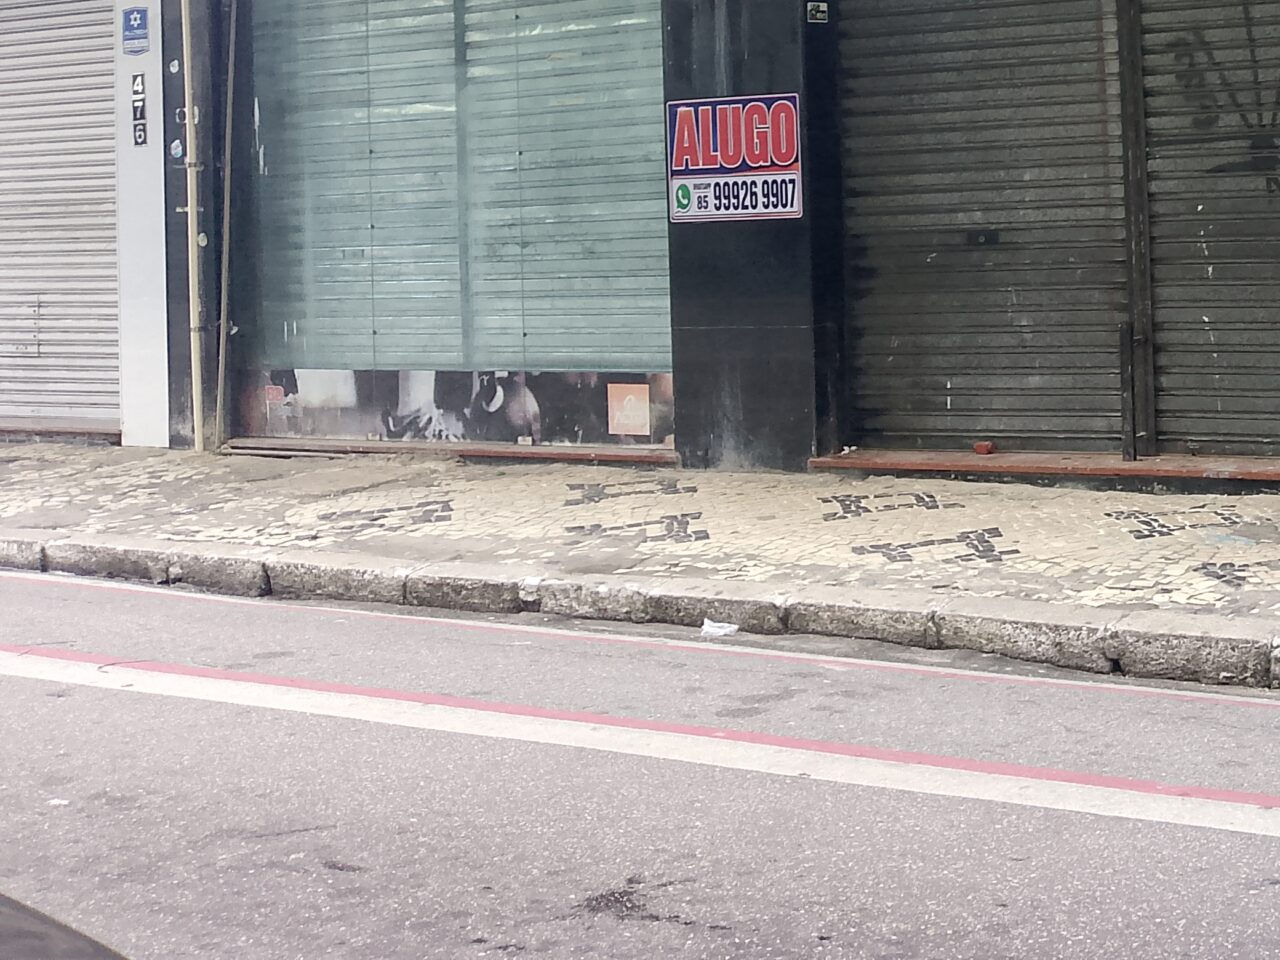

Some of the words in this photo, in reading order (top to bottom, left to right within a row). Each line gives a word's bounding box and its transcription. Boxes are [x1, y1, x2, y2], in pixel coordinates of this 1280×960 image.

[132, 74, 146, 144] 476
[671, 100, 798, 170] ALUGO
[696, 195, 709, 210] 85
[713, 180, 758, 211] 99926
[761, 178, 796, 210] 9907
